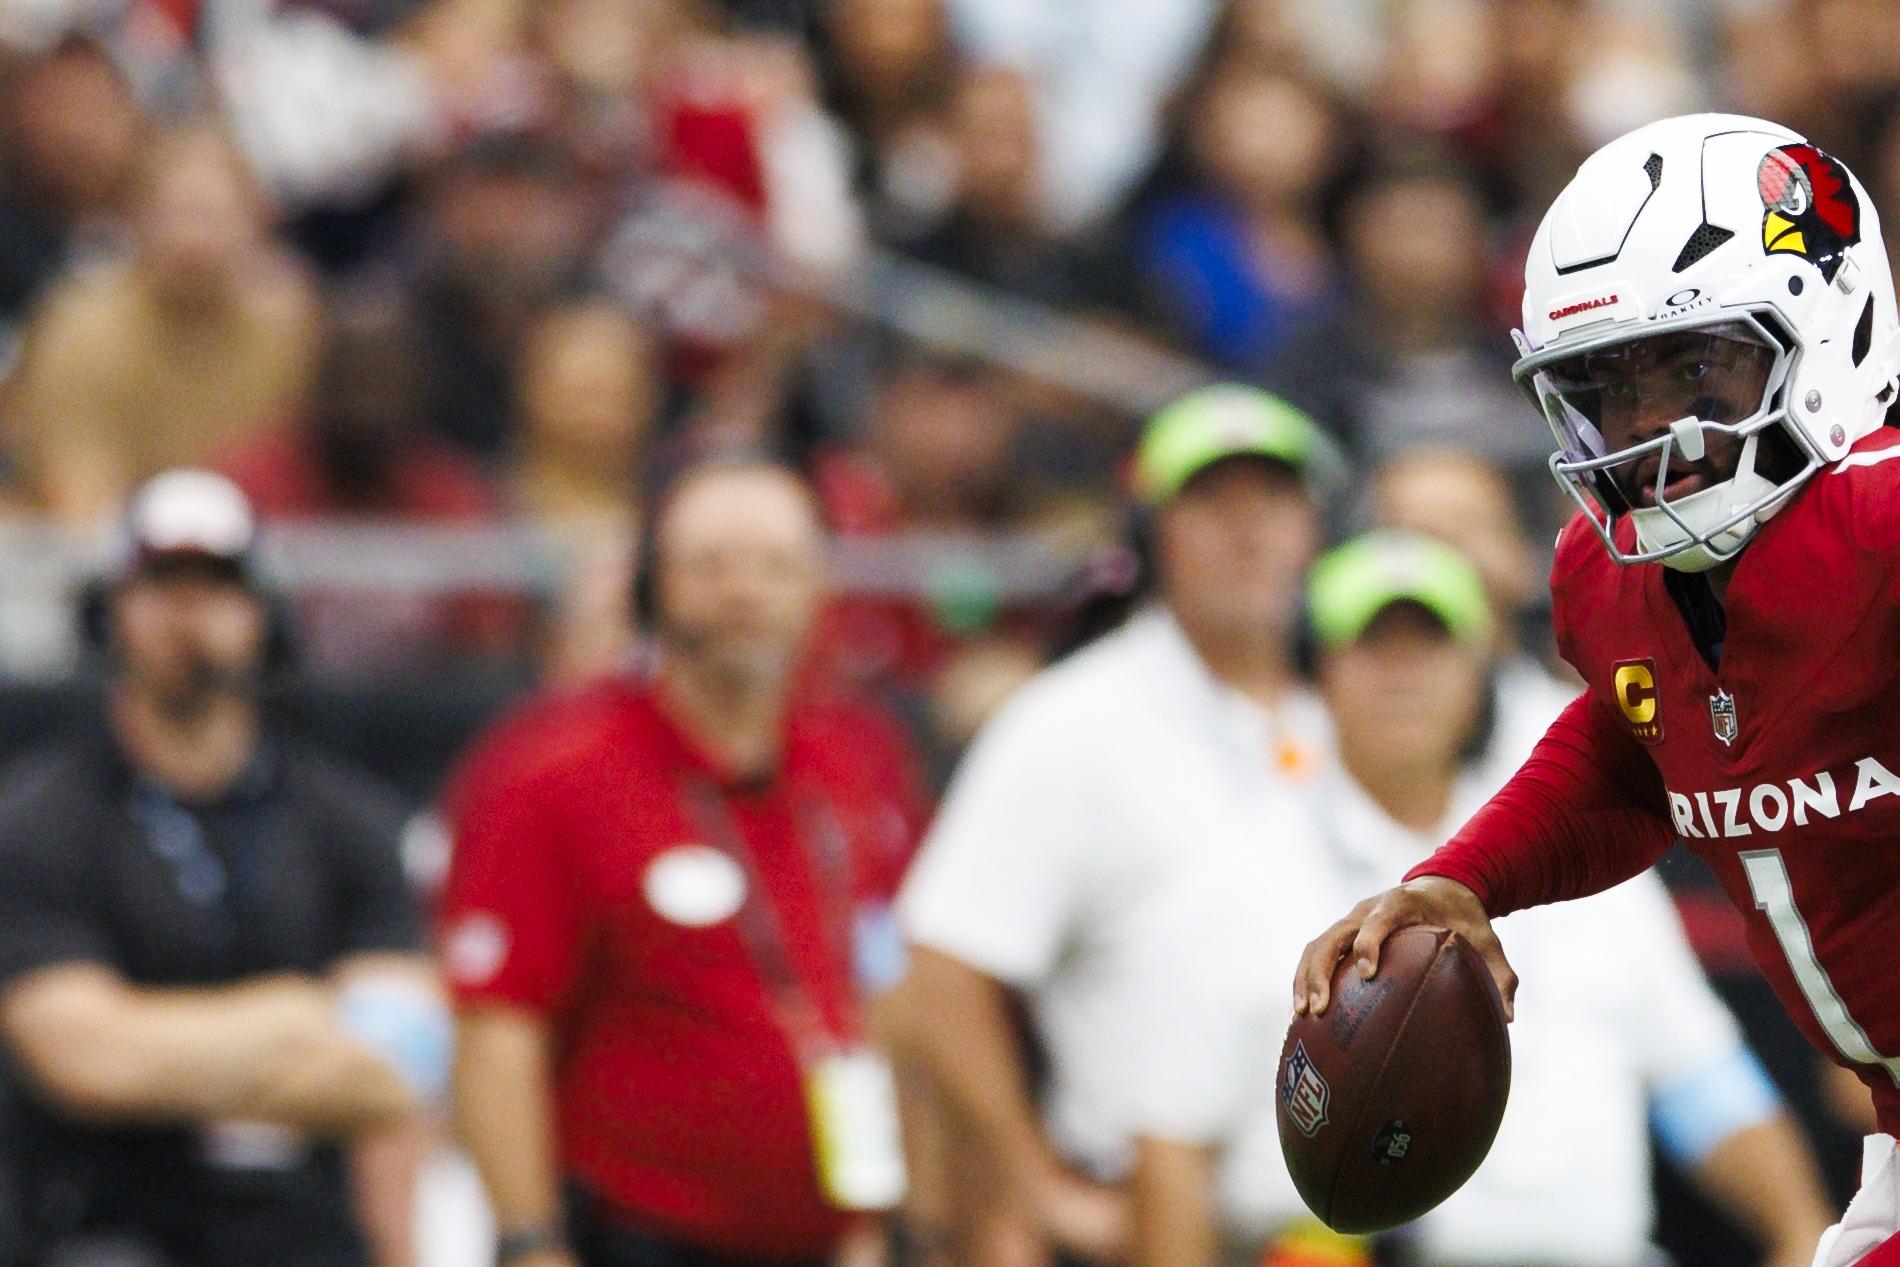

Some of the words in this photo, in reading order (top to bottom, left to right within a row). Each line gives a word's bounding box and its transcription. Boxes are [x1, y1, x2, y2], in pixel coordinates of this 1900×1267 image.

[1549, 295, 1619, 320] CARDINALS
[1615, 665, 1656, 723] C
[1291, 1073, 1324, 1129] NFL
[1387, 1132, 1411, 1158] 056
